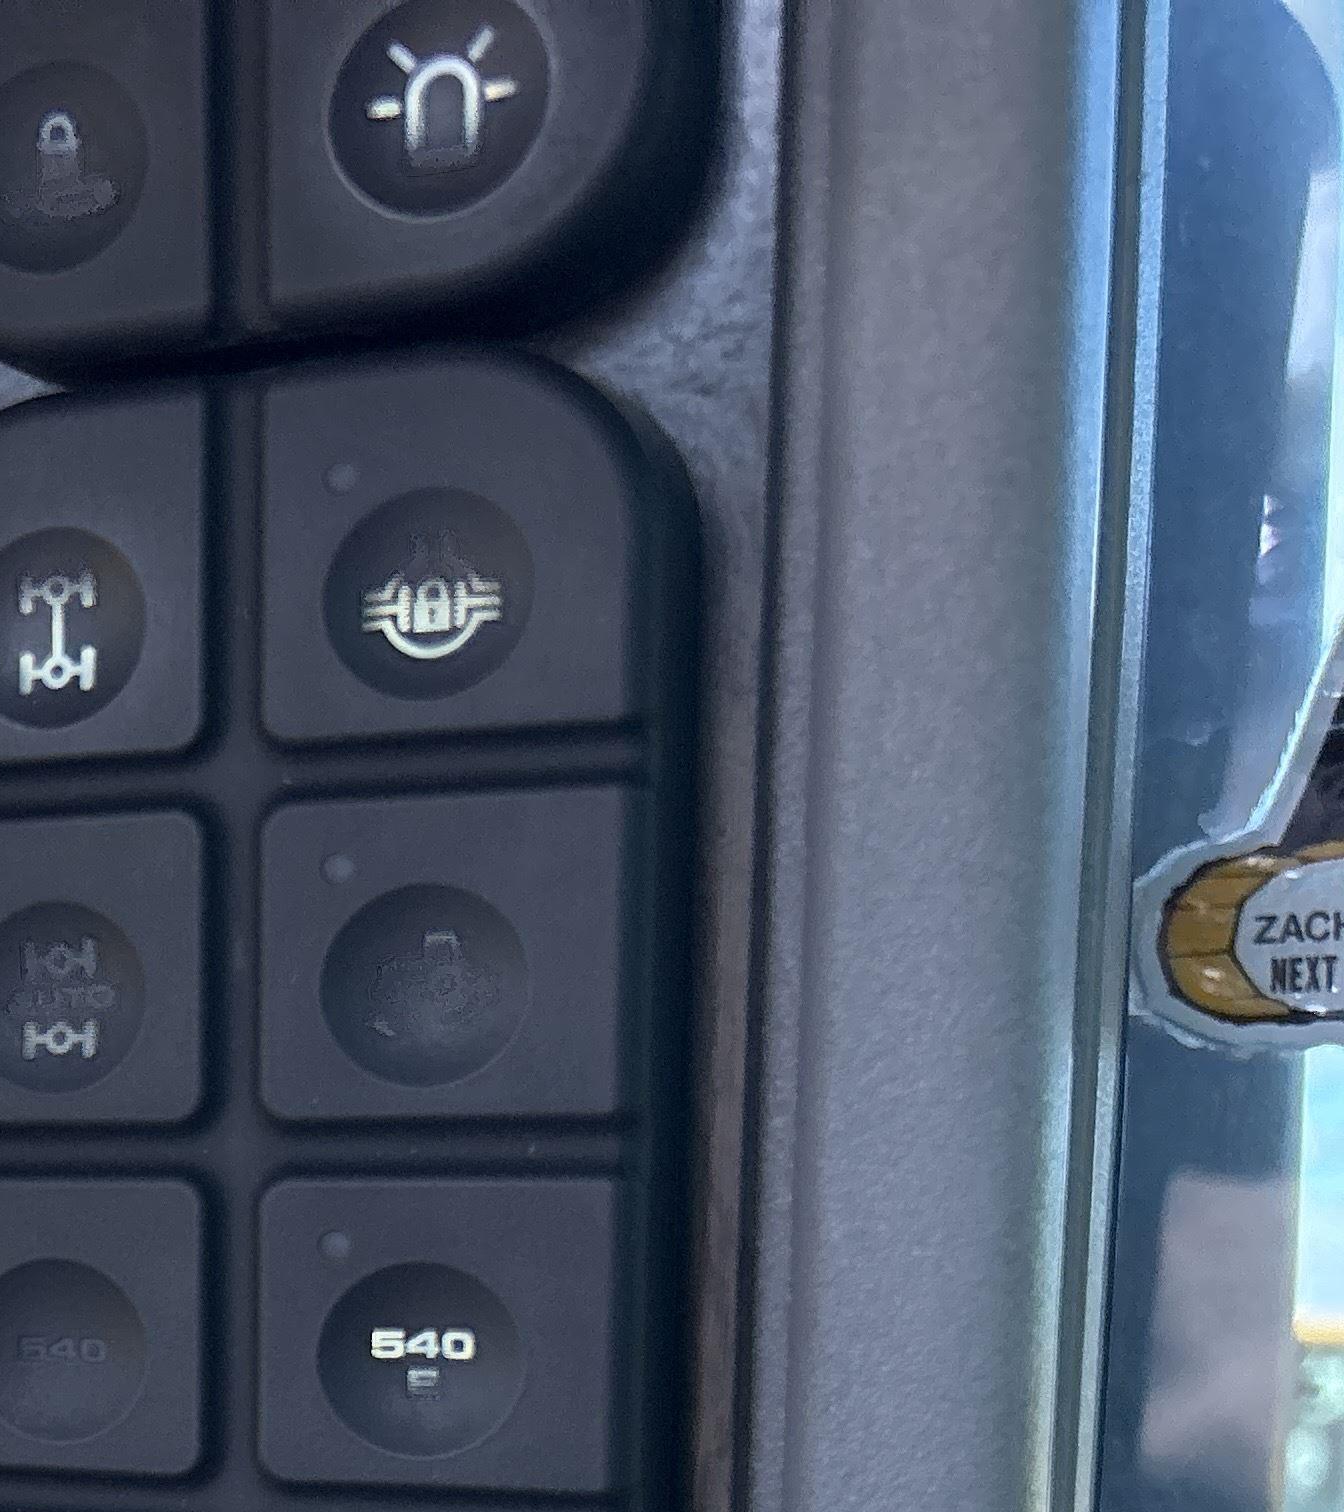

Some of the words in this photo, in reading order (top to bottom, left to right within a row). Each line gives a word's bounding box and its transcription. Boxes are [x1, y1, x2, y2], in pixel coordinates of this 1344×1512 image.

[1270, 955, 1337, 993] NEXT
[18, 1336, 108, 1364] 540
[371, 1328, 476, 1360] 540
